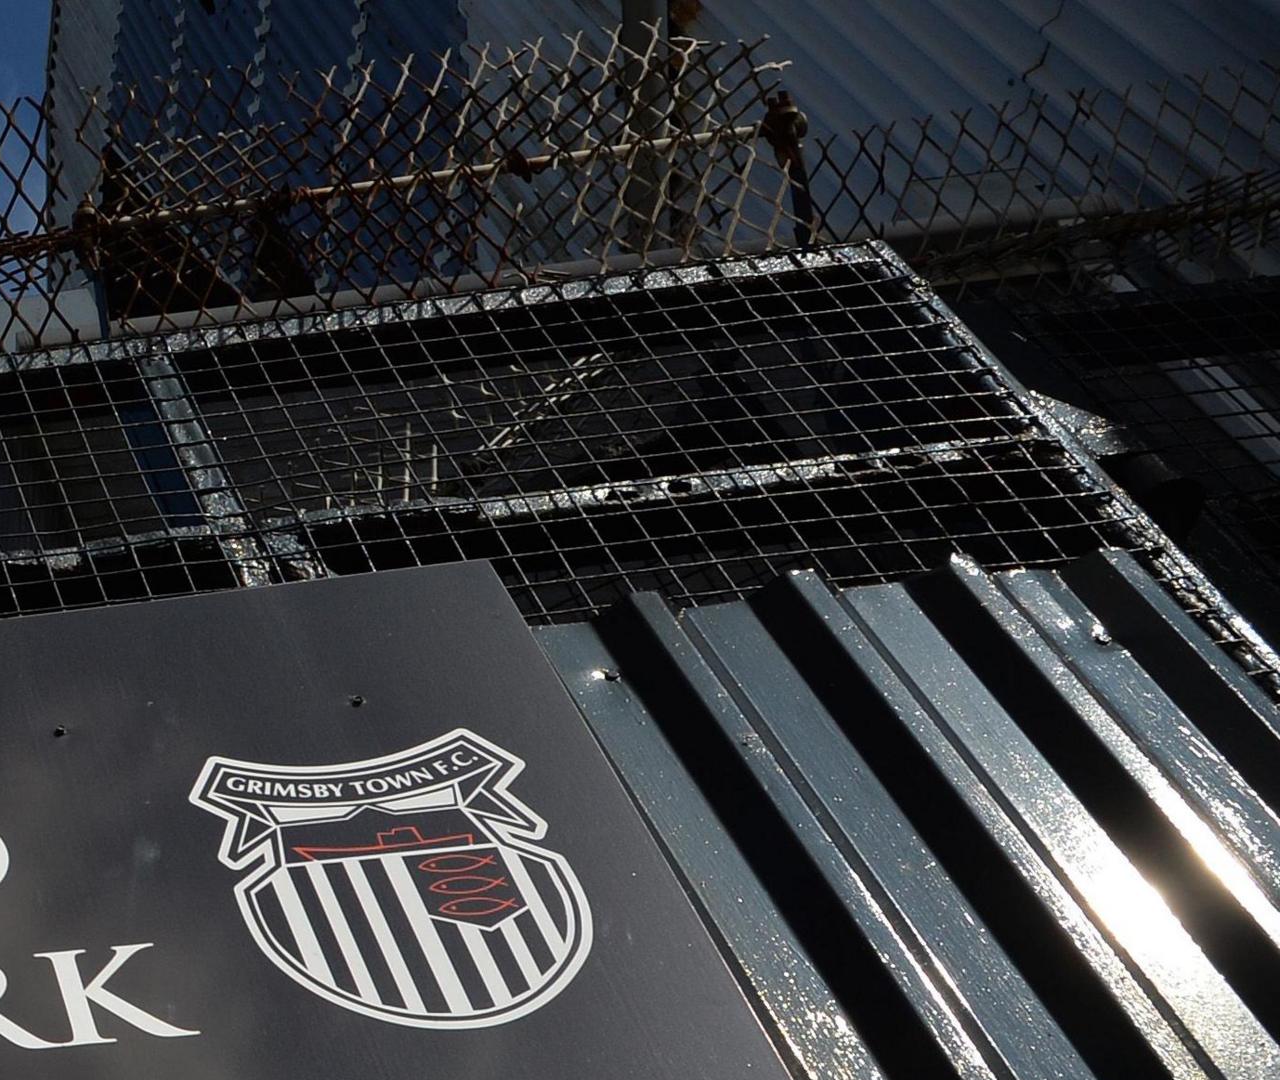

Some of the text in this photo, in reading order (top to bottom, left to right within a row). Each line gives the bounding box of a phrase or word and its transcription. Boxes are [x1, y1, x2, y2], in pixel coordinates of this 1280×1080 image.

[226, 751, 479, 799] GRIMSBY TOWN F.C.
